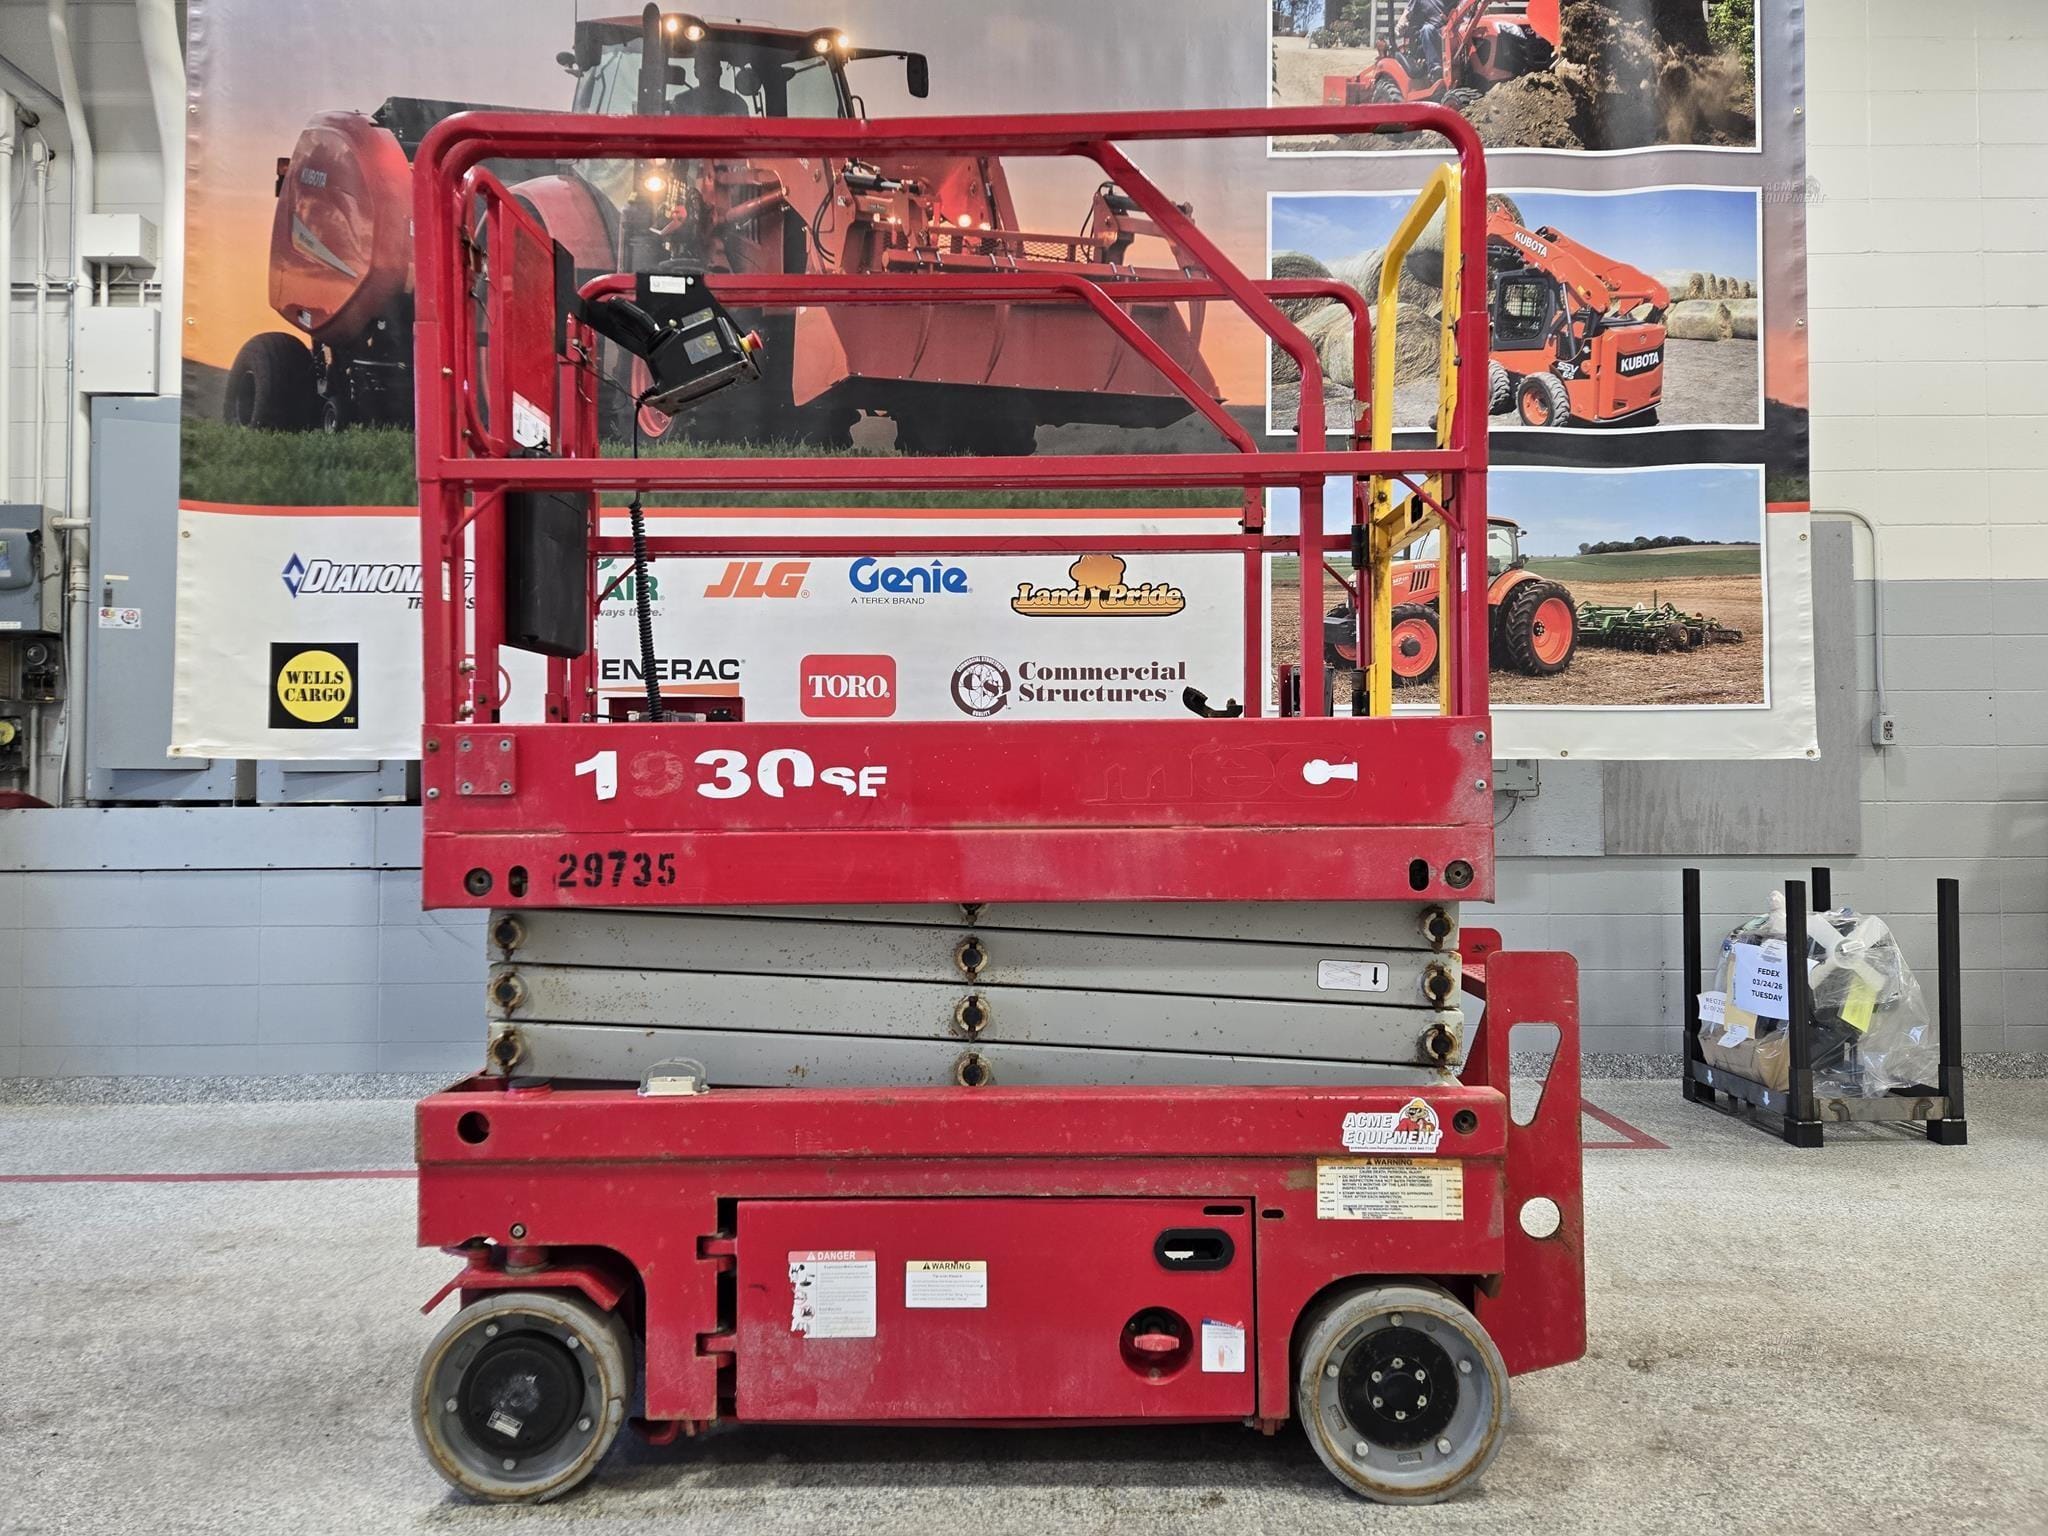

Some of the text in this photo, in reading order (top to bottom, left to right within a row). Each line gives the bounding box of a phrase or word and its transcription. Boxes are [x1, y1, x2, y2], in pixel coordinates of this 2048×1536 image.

[1514, 231, 1548, 258] KUBOTA
[1557, 361, 1579, 373] SSV
[1620, 351, 1659, 372] KUBOTA
[300, 559, 423, 594] DIAMON
[703, 562, 811, 598] JLG
[849, 556, 968, 594] Genie
[851, 597, 925, 605] A TEREX BRAND
[1016, 583, 1182, 606] Land Pride
[285, 670, 344, 685] WELLS
[602, 659, 740, 680] ENERAC
[1018, 661, 1186, 681] Commercial
[284, 688, 345, 702] CARGO
[808, 675, 888, 698] TORO
[1018, 683, 1167, 702] Structures
[557, 851, 676, 888] 29735
[1757, 967, 1780, 978] FEDEX
[1752, 978, 1783, 990] 03/24/26
[1751, 990, 1783, 1002] TUESDAY
[1345, 1114, 1393, 1129] ACME
[1344, 1130, 1440, 1146] EQUIPMENT
[817, 1251, 856, 1260] DANGER
[932, 1262, 971, 1270] WARNING
